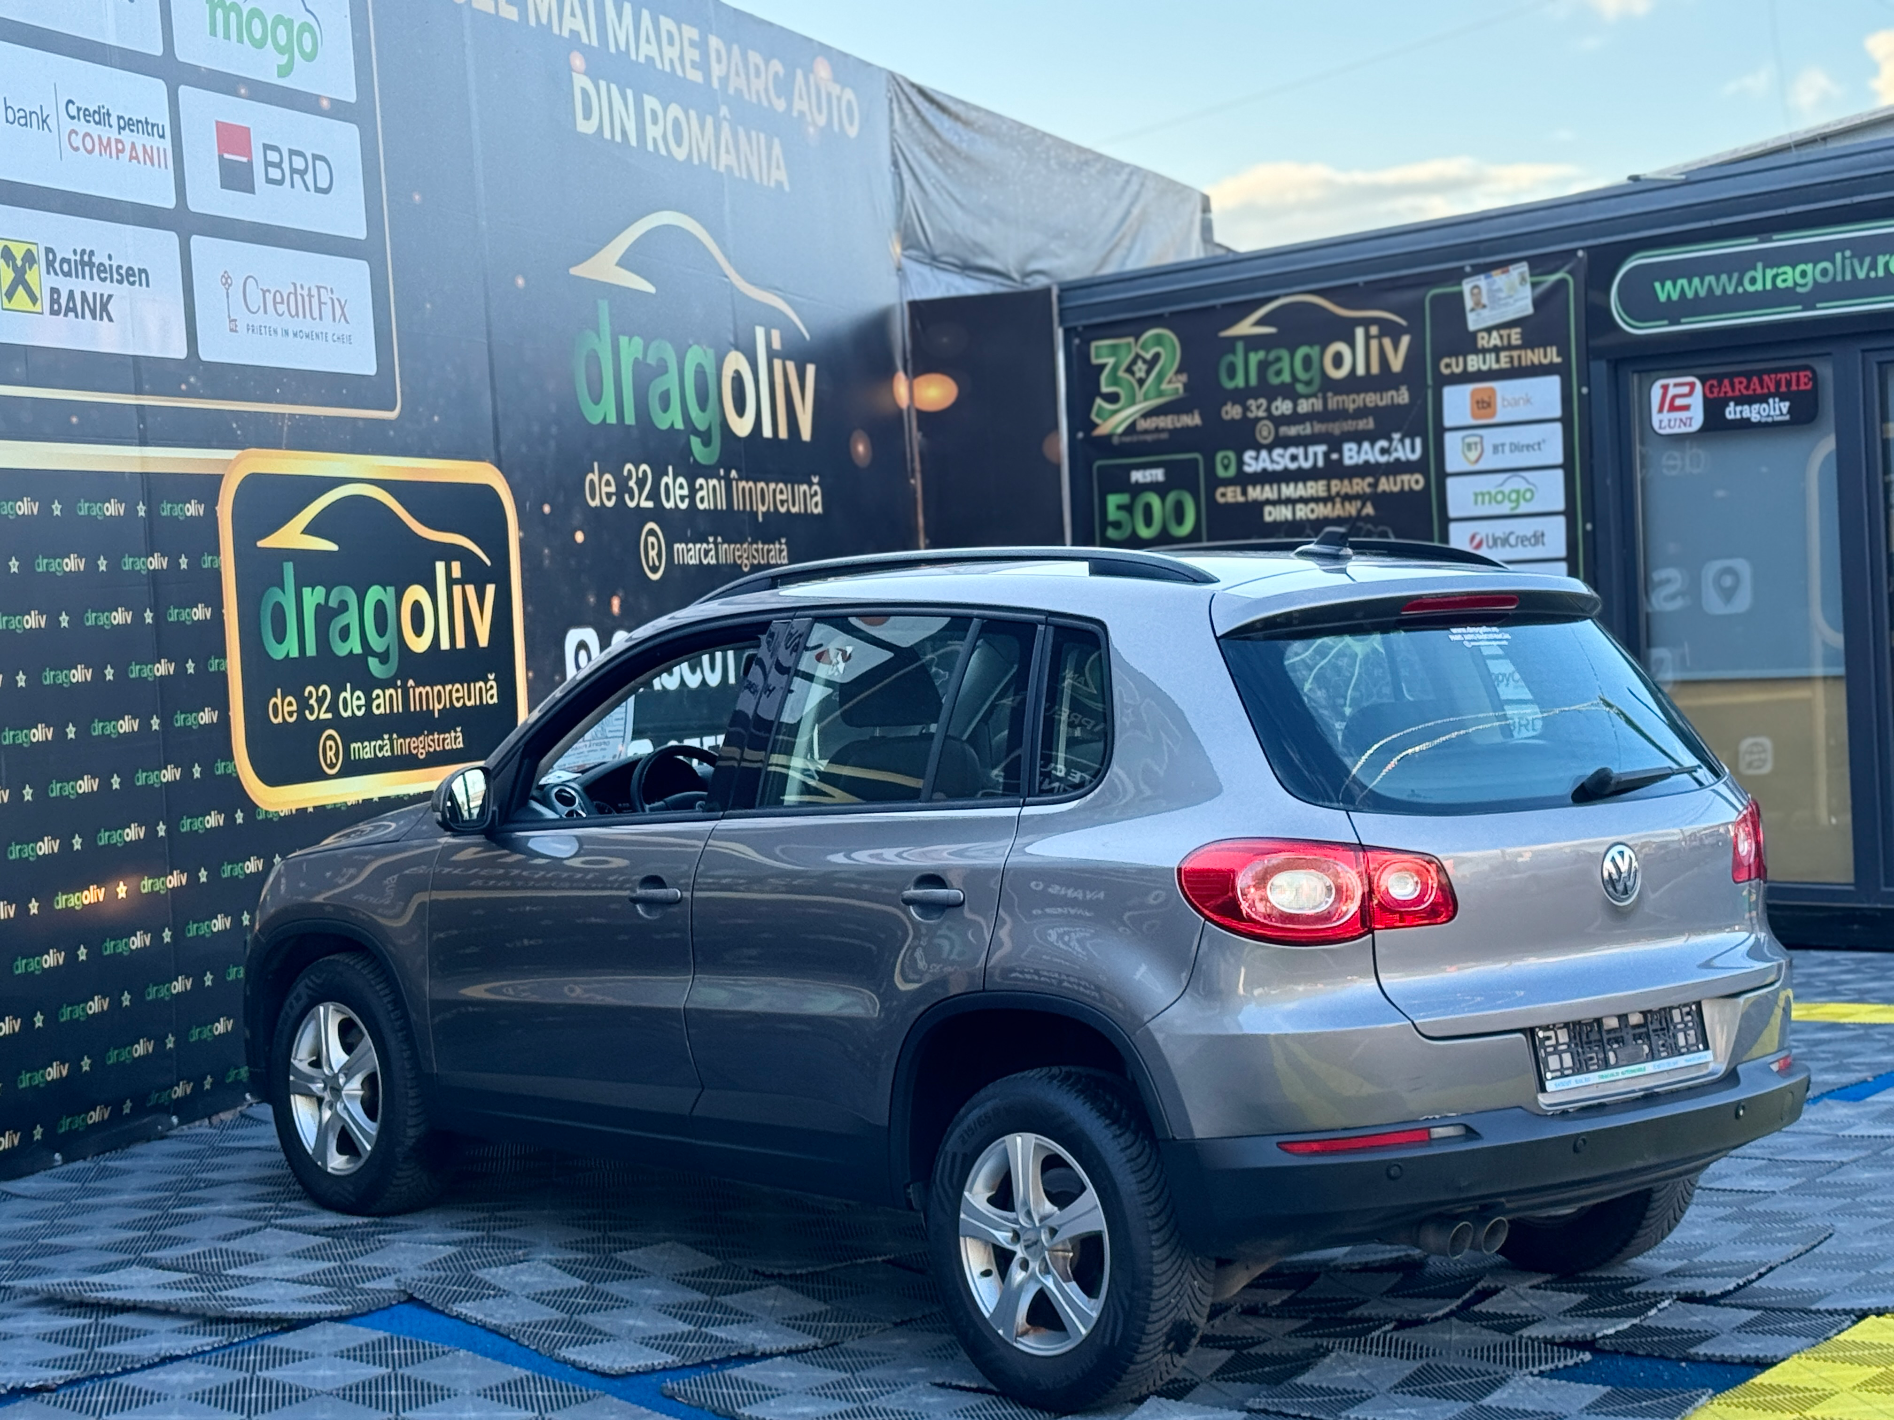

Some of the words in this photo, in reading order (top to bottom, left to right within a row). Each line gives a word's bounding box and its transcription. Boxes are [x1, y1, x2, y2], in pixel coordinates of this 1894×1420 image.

[206, 0, 318, 78] mogo
[605, 0, 703, 83] MARE
[708, 34, 786, 112] PARC
[792, 68, 859, 138] AUTO
[4, 97, 52, 133] bank
[65, 99, 113, 130] Credit
[117, 113, 165, 140] pentru
[572, 72, 637, 147] DIN
[643, 94, 790, 192] ROMÂNIA
[67, 128, 168, 170] COMPANII
[262, 143, 334, 194] BRD
[44, 247, 150, 288] Raiffeisen
[1654, 250, 1894, 302] www.dragoliv.r
[49, 288, 114, 322] BANK
[243, 275, 350, 324] CreditFix
[247, 323, 278, 337] PRIETEN
[281, 329, 289, 338] IN
[292, 330, 329, 342] MOMENTE
[332, 333, 353, 345] CHEIE
[1477, 328, 1522, 349] RATE
[1090, 327, 1183, 424] 32
[1219, 324, 1411, 395] dragoliv
[1440, 355, 1463, 375] CU
[1467, 346, 1562, 373] BULETINUL
[574, 299, 816, 465] dragoliv
[1657, 381, 1696, 414] 12
[1704, 370, 1813, 399] GARANTIE
[1221, 402, 1242, 420] de
[1246, 399, 1267, 418] 32
[1271, 397, 1293, 416] de
[1297, 393, 1323, 414] ani
[1327, 385, 1409, 413] împreună
[1475, 395, 1492, 411] tbi
[1501, 393, 1533, 409] bank
[1725, 397, 1790, 422] dragoliv
[1658, 416, 1694, 430] LUNI
[1243, 444, 1327, 473] SASCUT
[1342, 432, 1422, 467] BACĂU
[1492, 443, 1506, 455] BT
[585, 462, 616, 508] de
[623, 463, 654, 509] 32
[660, 465, 689, 509] de
[695, 468, 727, 511] ani
[731, 469, 823, 523] împreună
[1130, 468, 1165, 484] PESTE
[1215, 485, 1246, 503] CEL
[1247, 484, 1278, 501] MAI
[1280, 480, 1328, 499] MARE
[1329, 477, 1375, 496] PARC
[1377, 473, 1424, 493] AUTO
[0, 497, 39, 519] agoliv
[77, 498, 125, 520] dragoliv
[160, 499, 204, 520] dragoliv
[1105, 489, 1196, 541] 500
[1264, 505, 1293, 522] DIN
[1473, 487, 1534, 513] mogo
[674, 536, 716, 565] marcă
[717, 537, 789, 573] înregistrată
[1486, 530, 1546, 550] UniCredit
[35, 554, 86, 576] dragoliv
[122, 553, 168, 574] dragoliv
[84, 607, 132, 629] dragoliv
[167, 604, 212, 625] dragoliv
[260, 561, 496, 679] dragoliv
[42, 664, 92, 687] dragoliv
[128, 658, 175, 681] dragoliv
[268, 688, 298, 724] de
[304, 684, 332, 721] 32
[338, 683, 366, 718] de
[372, 680, 403, 715] ani
[407, 673, 498, 718] împreună
[1, 723, 53, 747] dragoliv
[91, 715, 139, 738] dragoliv
[174, 707, 218, 729] dragoliv
[350, 729, 391, 761] marcă
[392, 726, 464, 759] înregistrată
[48, 774, 99, 798] dragoliv
[135, 764, 181, 787] dragoliv
[7, 836, 60, 861] dragoliv
[97, 823, 146, 847] dragoliv
[180, 811, 224, 833] dragoliv
[54, 885, 105, 910] dragoliv
[140, 870, 188, 894] dragoliv
[220, 855, 264, 878] dragoliv
[13, 949, 65, 975] dragoliv
[102, 931, 151, 956] dragoliv
[186, 914, 231, 937] dragoliv
[59, 995, 109, 1022] dragoliv
[145, 975, 193, 1000] dragoliv
[18, 1061, 69, 1090] dragoliv
[106, 1037, 154, 1064] dragoliv
[188, 1016, 233, 1042] dragoliv
